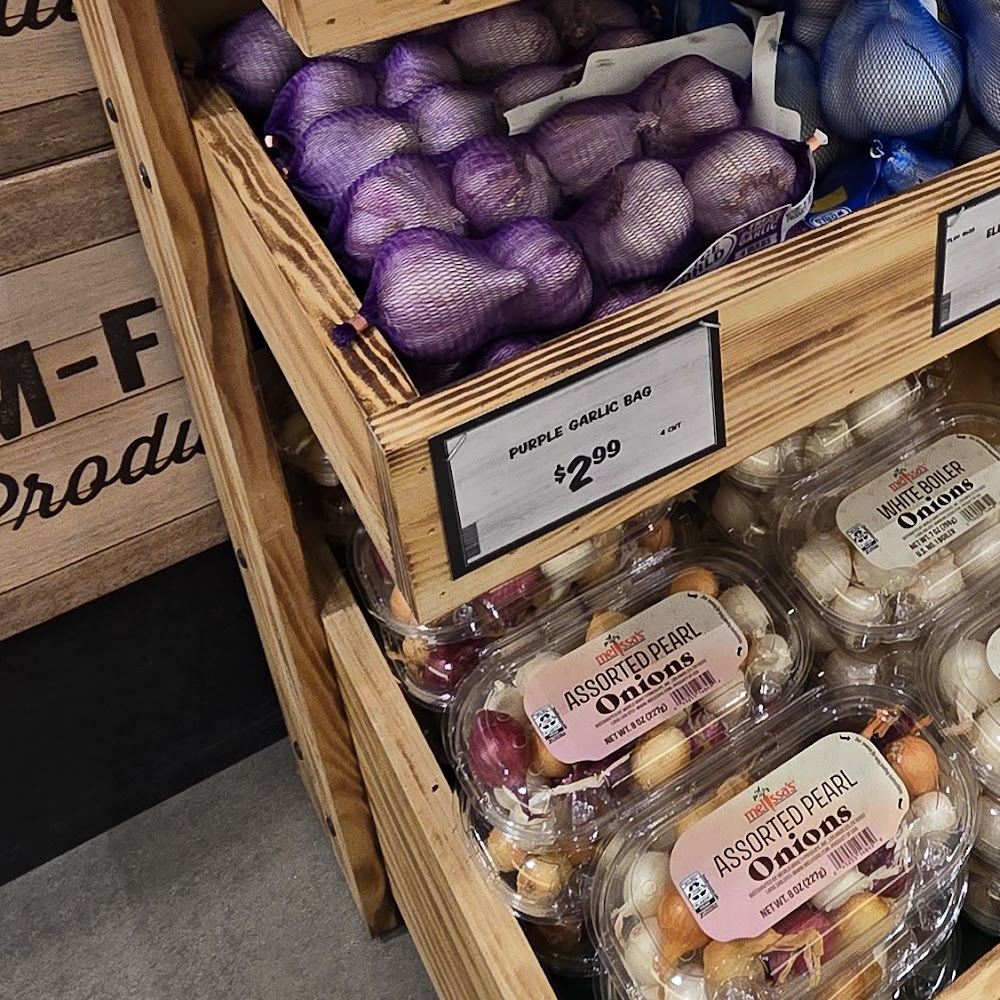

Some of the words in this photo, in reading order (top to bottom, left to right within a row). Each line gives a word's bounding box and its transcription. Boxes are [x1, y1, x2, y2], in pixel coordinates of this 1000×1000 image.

[509, 425, 564, 460] PURPLE
[569, 400, 619, 432] GARLIC
[624, 386, 652, 408] BAG
[877, 486, 924, 520] WHITE
[920, 460, 966, 495] BOILER
[898, 479, 974, 529] Onions
[563, 651, 649, 711] ASSORTED
[648, 622, 702, 663] PEARL
[595, 630, 646, 666] melissa's
[596, 651, 695, 715] Onions
[602, 731, 619, 745] NET
[617, 723, 632, 736] WT.
[634, 714, 646, 725] OZ
[713, 804, 804, 877] ASSORTED
[800, 769, 858, 815] PEARL
[745, 780, 798, 824] melissa's
[748, 804, 852, 882] Onions
[758, 902, 776, 918] NET
[772, 892, 790, 908] WT.
[792, 882, 804, 894] OZ
[800, 866, 829, 889] (227g)
